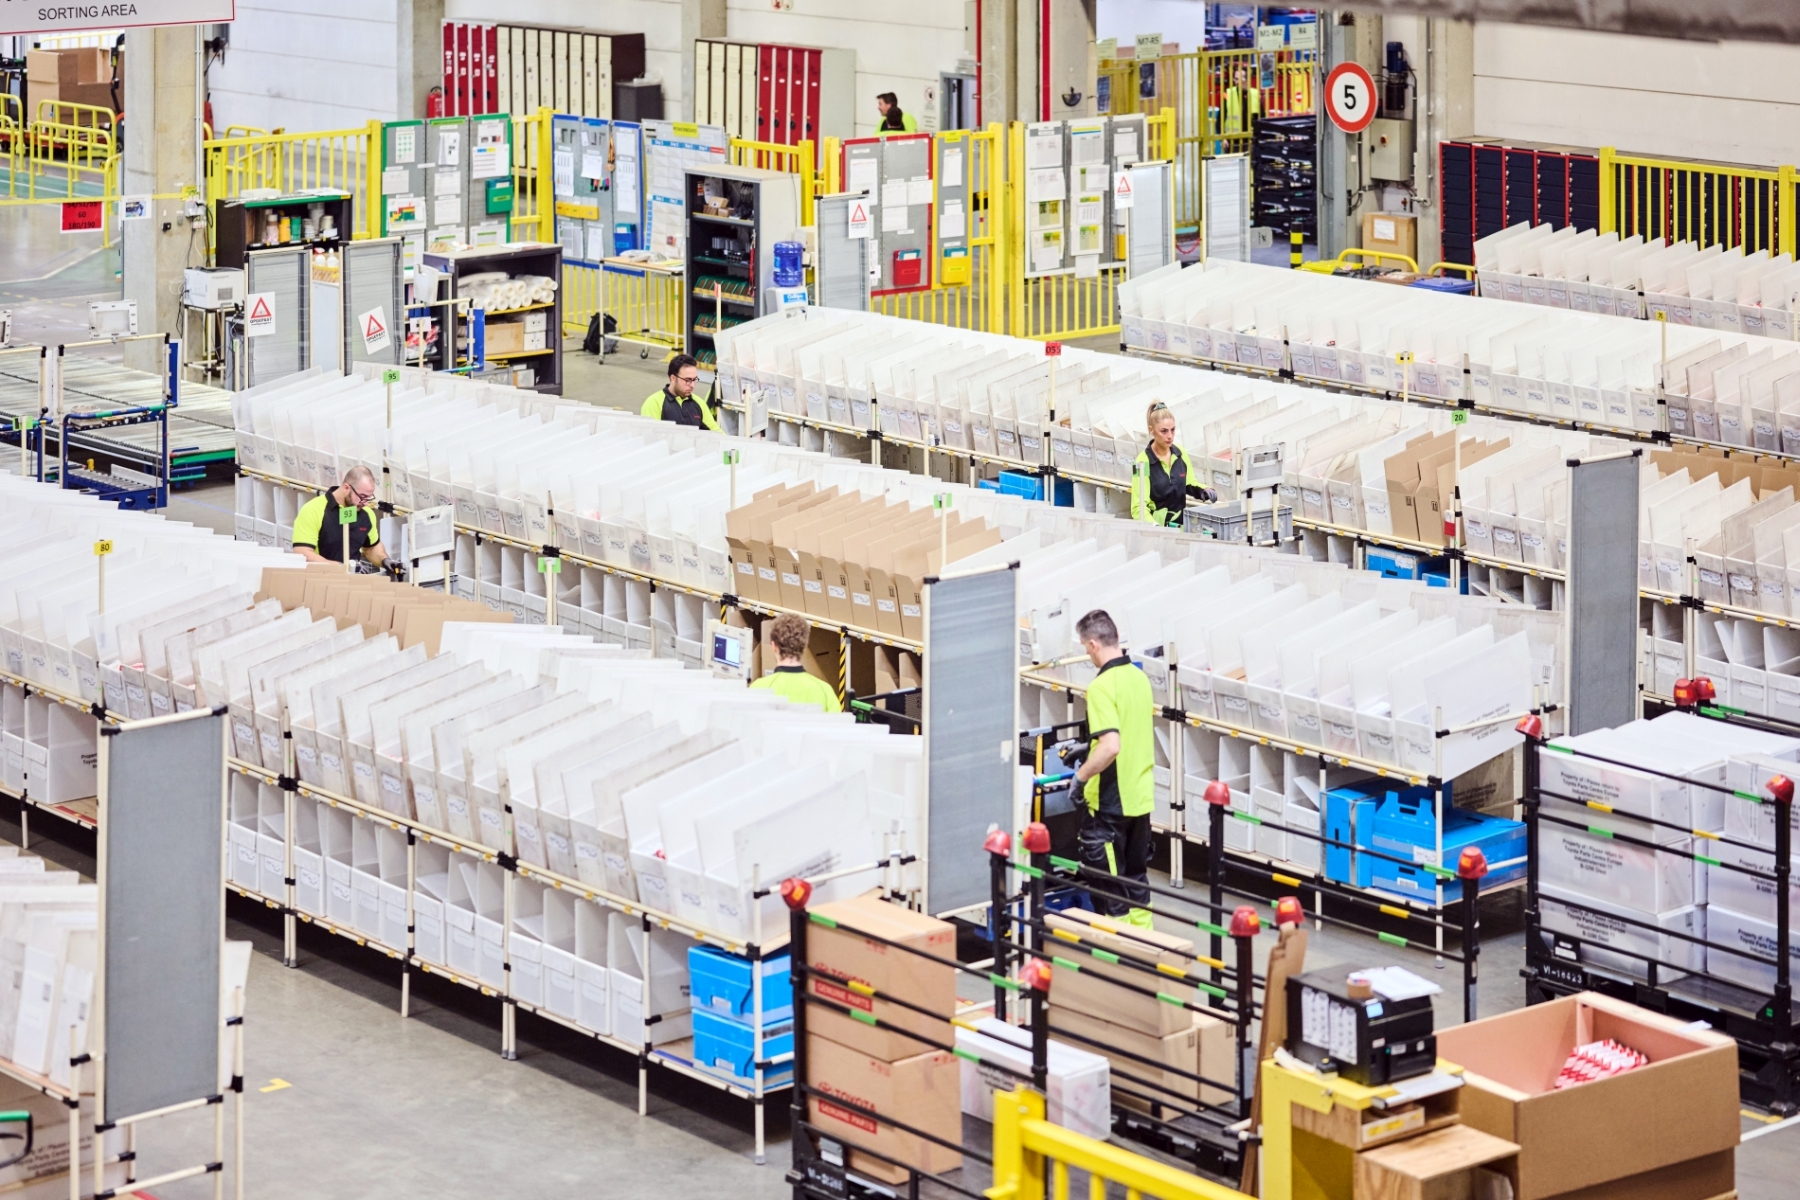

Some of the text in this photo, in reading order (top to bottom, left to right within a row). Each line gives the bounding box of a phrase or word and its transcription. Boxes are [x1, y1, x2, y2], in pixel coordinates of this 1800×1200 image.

[38, 4, 138, 20] SORTING AREA
[1344, 84, 1356, 110] 5
[344, 510, 352, 518] 93
[100, 543, 109, 551] 80
[818, 980, 871, 1010] GENUINE PARTS
[852, 1114, 874, 1132] PARTS
